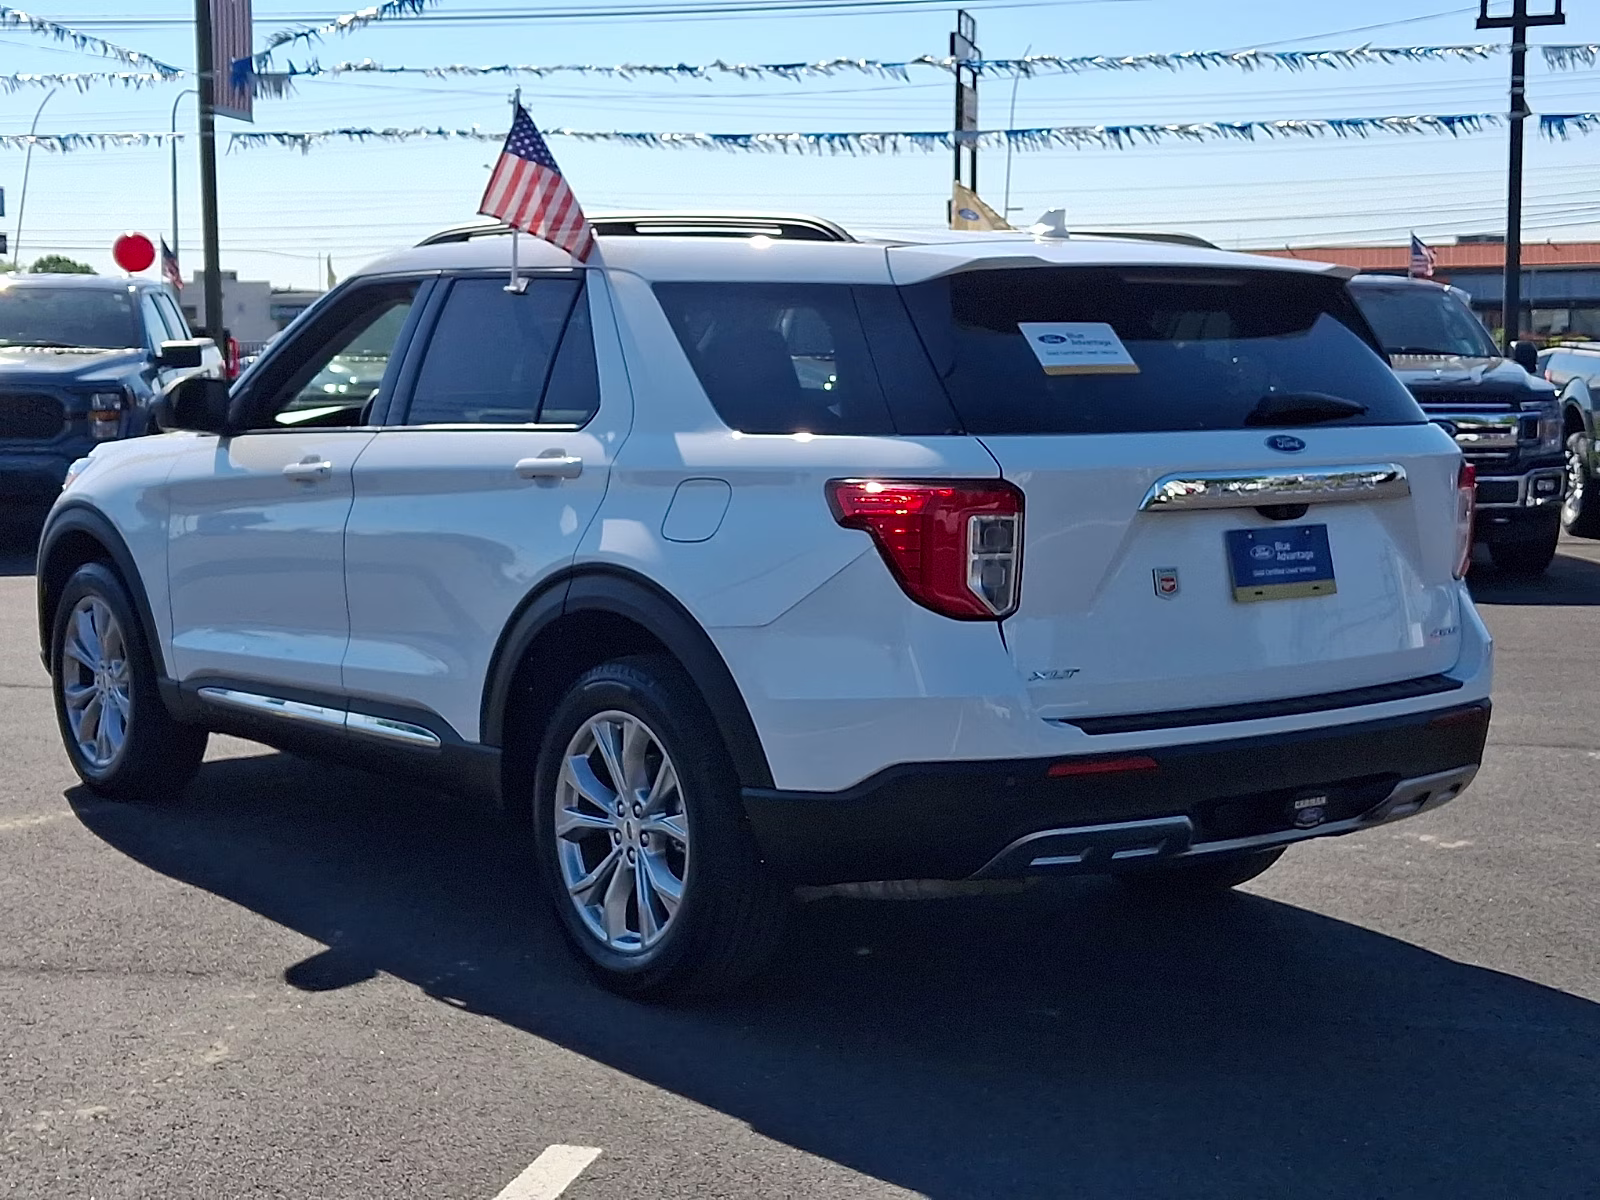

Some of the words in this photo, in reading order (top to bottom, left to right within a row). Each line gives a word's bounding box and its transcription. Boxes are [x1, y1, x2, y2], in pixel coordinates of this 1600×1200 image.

[1275, 436, 1301, 449] Ford
[1274, 541, 1290, 551] Blue
[1276, 551, 1314, 561] Advantage
[1027, 667, 1080, 681] XLT
